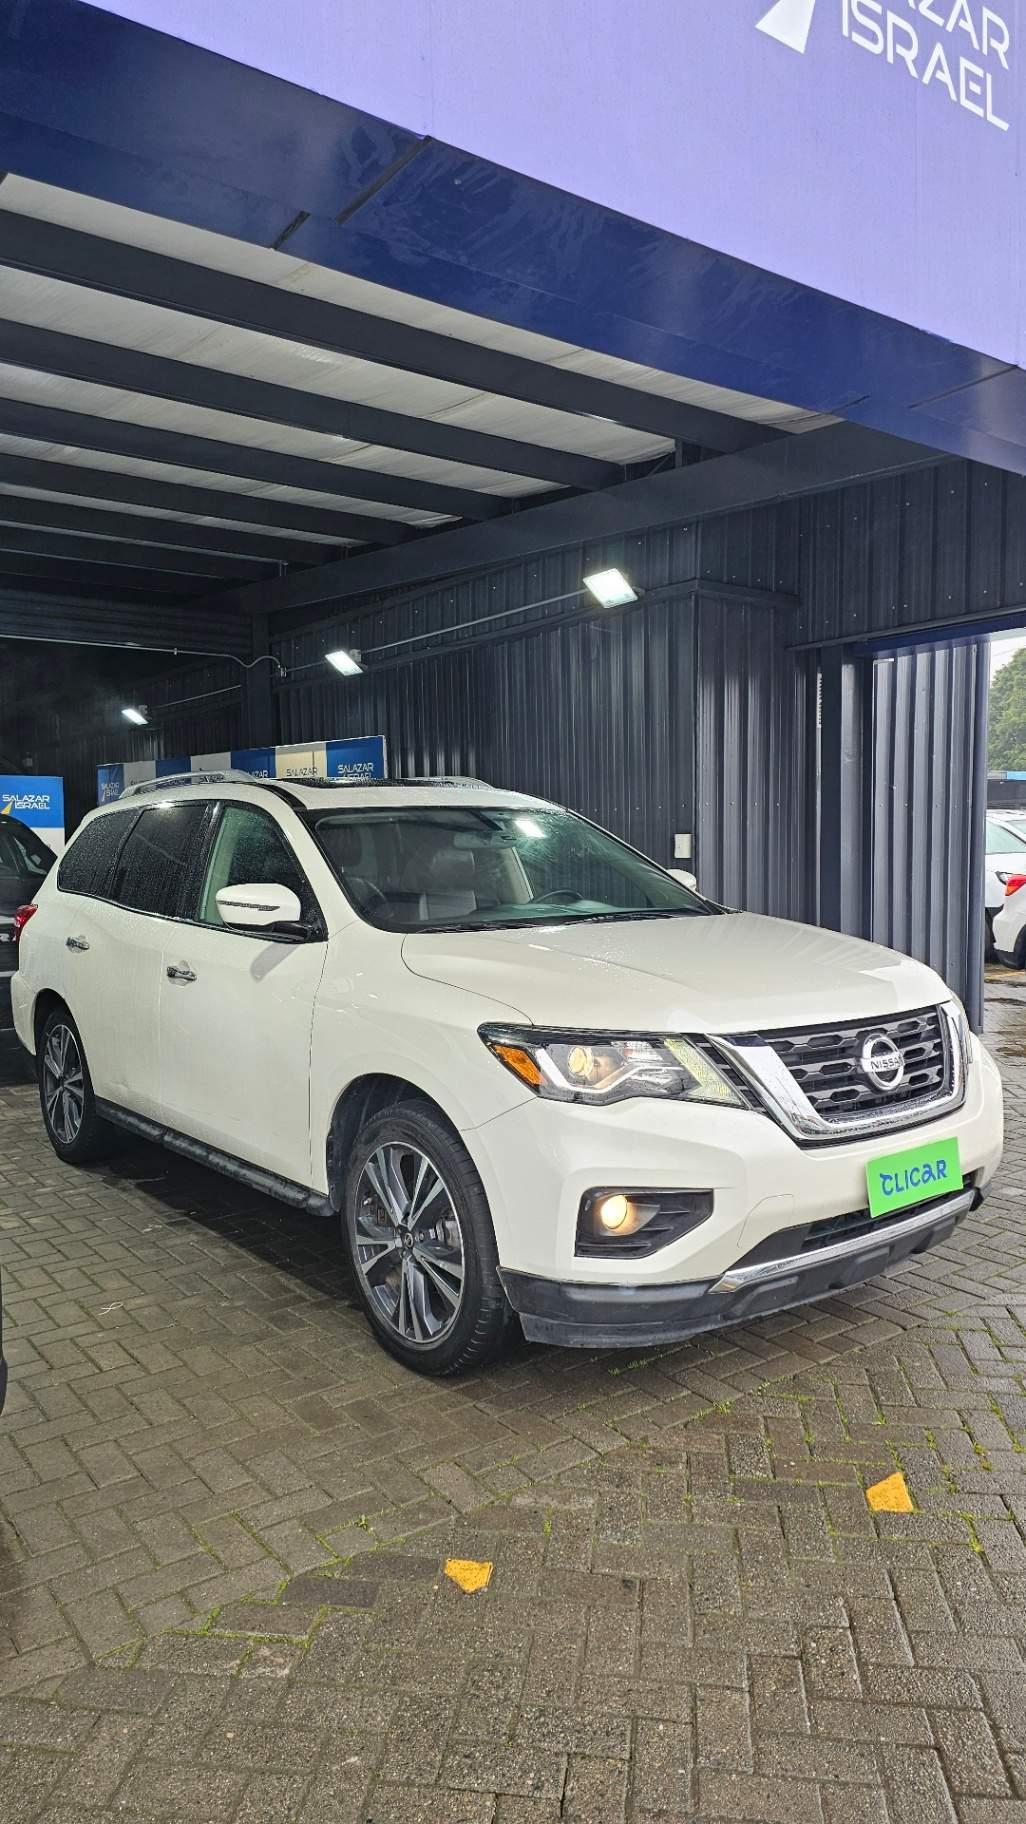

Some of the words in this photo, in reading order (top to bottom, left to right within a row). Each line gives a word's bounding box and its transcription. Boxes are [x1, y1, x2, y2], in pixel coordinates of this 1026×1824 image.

[842, 0, 1009, 131] ISRAEL
[286, 767, 317, 777] SALAZAR
[337, 762, 374, 775] SALAZAR
[3, 794, 50, 802] SALAZAR
